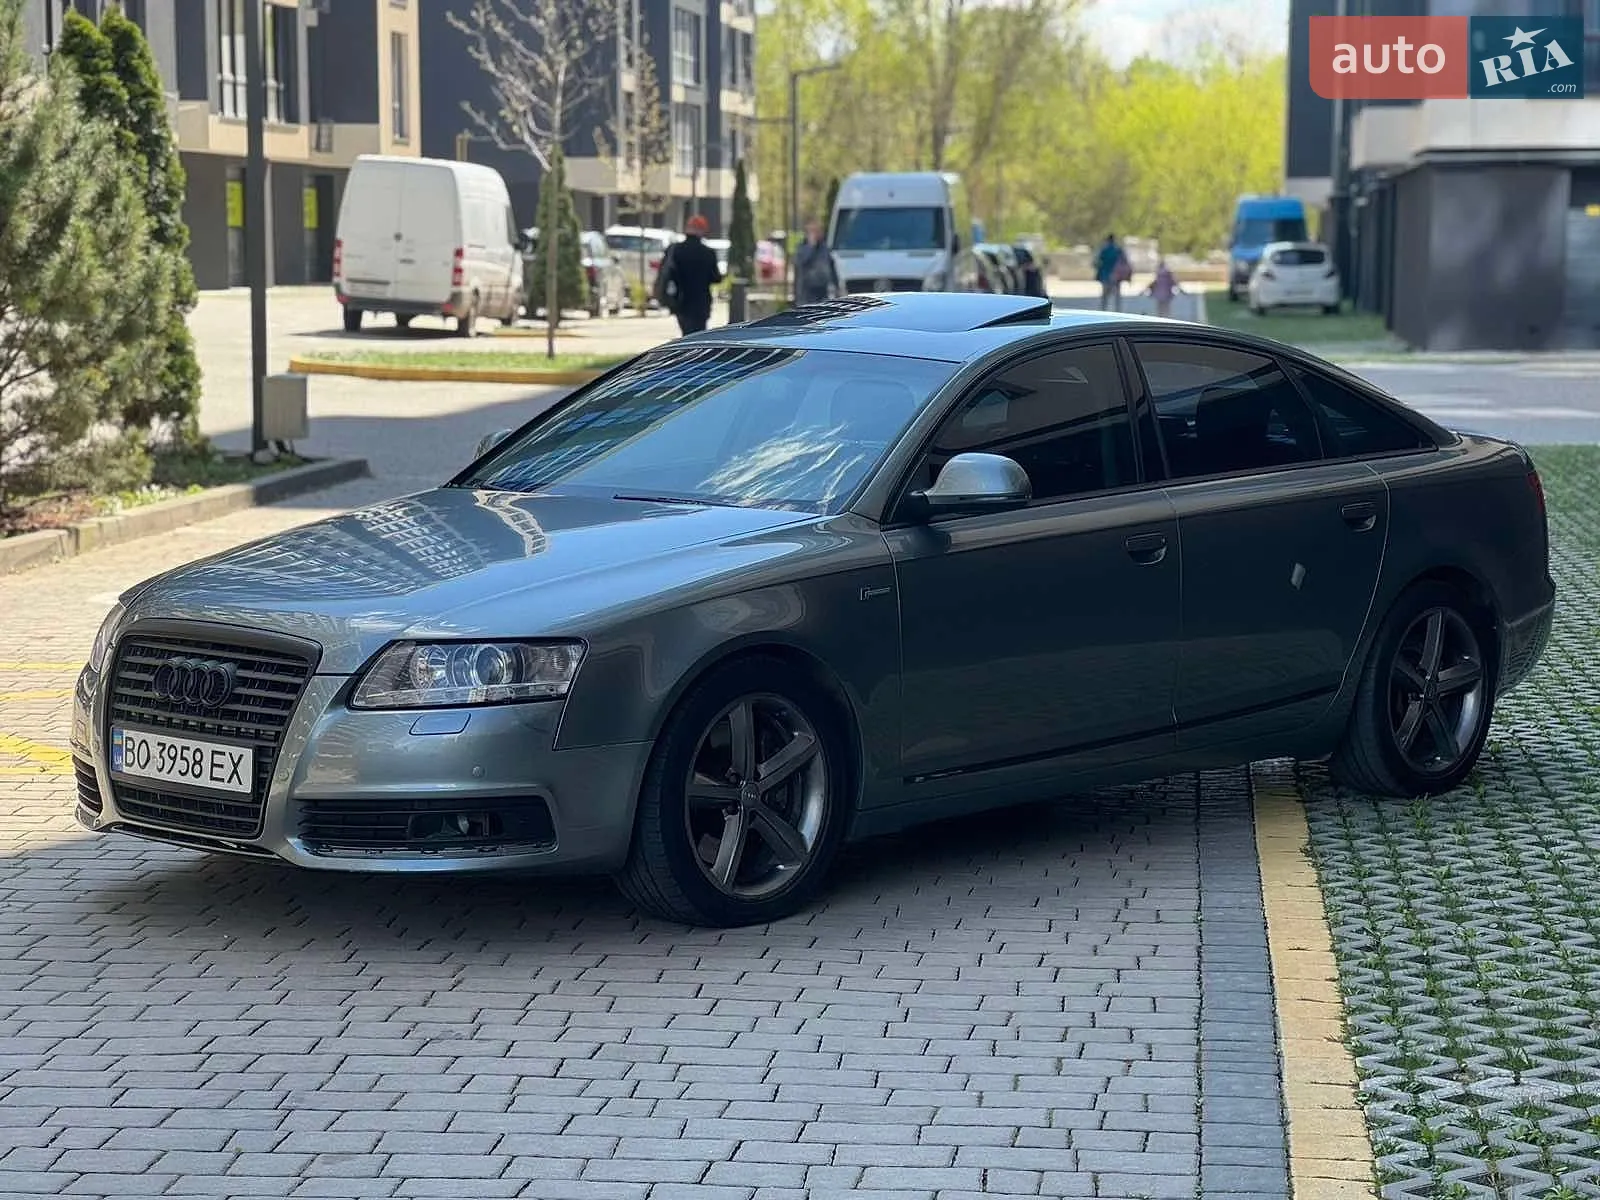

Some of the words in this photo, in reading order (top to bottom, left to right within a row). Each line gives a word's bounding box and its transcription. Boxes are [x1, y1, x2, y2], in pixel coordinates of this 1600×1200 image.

[124, 736, 151, 769] BO
[155, 742, 203, 779] 3958
[209, 750, 244, 785] EX
